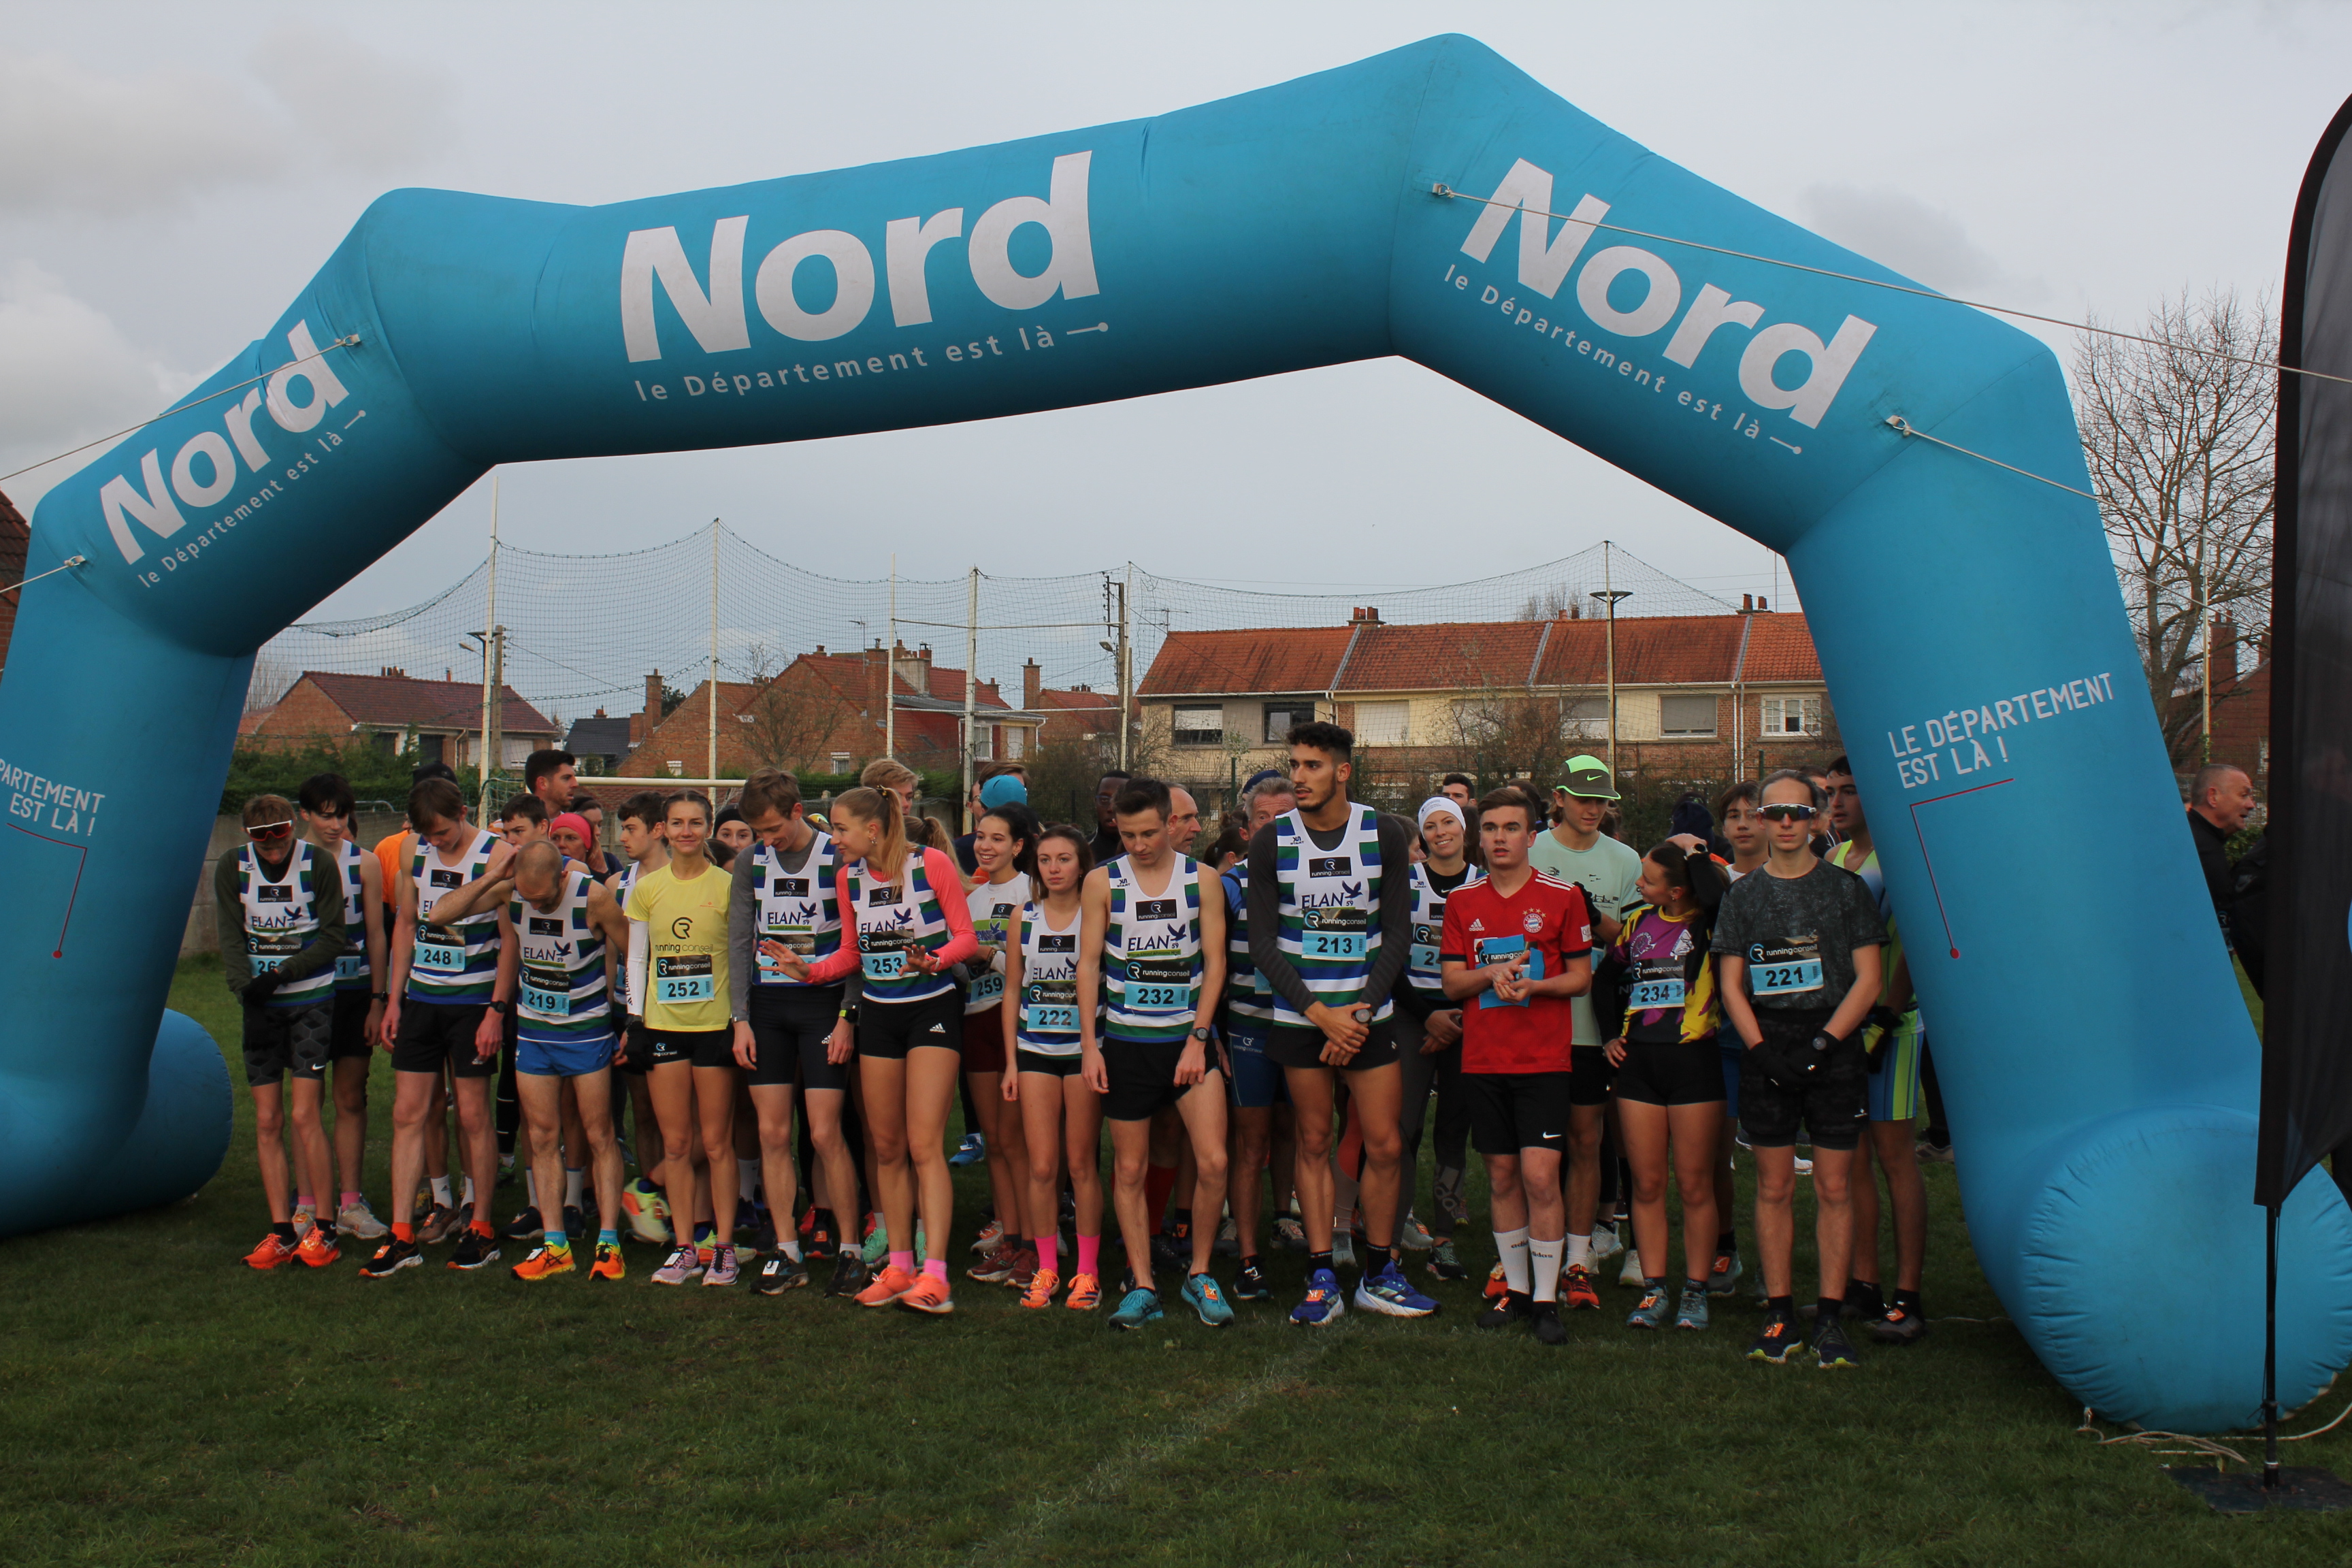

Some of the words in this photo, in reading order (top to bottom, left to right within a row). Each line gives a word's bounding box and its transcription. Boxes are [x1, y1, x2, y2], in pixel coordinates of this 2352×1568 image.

[621, 150, 1100, 363] Nord
[1460, 157, 1878, 430] Nord
[1444, 264, 1469, 291] le
[1480, 284, 1667, 393] Département
[1677, 389, 1723, 421] est
[1732, 412, 1761, 440] là
[635, 380, 668, 402] le
[683, 346, 928, 397] Département
[946, 334, 1003, 362] est
[1019, 325, 1056, 352] là
[100, 318, 350, 565] Nord
[137, 572, 161, 588] le
[161, 479, 284, 572] Département
[286, 451, 319, 480] est
[317, 431, 343, 453] là
[1887, 725, 1922, 758] LE
[1925, 672, 2114, 748] DÉPARTEMENT
[1897, 753, 1940, 789] EST
[1950, 738, 1991, 775] LÀ
[10, 792, 46, 822] EST
[51, 807, 78, 834] LÀ
[1301, 892, 1345, 909] ELAN
[251, 915, 287, 928] ELAN
[767, 912, 802, 925] ELAN
[1128, 934, 1171, 951] ELAN
[1317, 936, 1352, 954] 213
[424, 949, 451, 965] 248
[524, 947, 557, 962] ELAN
[258, 960, 278, 974] 26
[872, 957, 903, 974] 253
[1032, 966, 1068, 980] ELAN
[1765, 966, 1803, 987] 221
[668, 981, 700, 998] 252
[977, 977, 1003, 997] 259
[1137, 987, 1174, 1004] 232
[1641, 984, 1670, 1002] 234
[528, 991, 556, 1009] 219
[1039, 1010, 1072, 1026] 222
